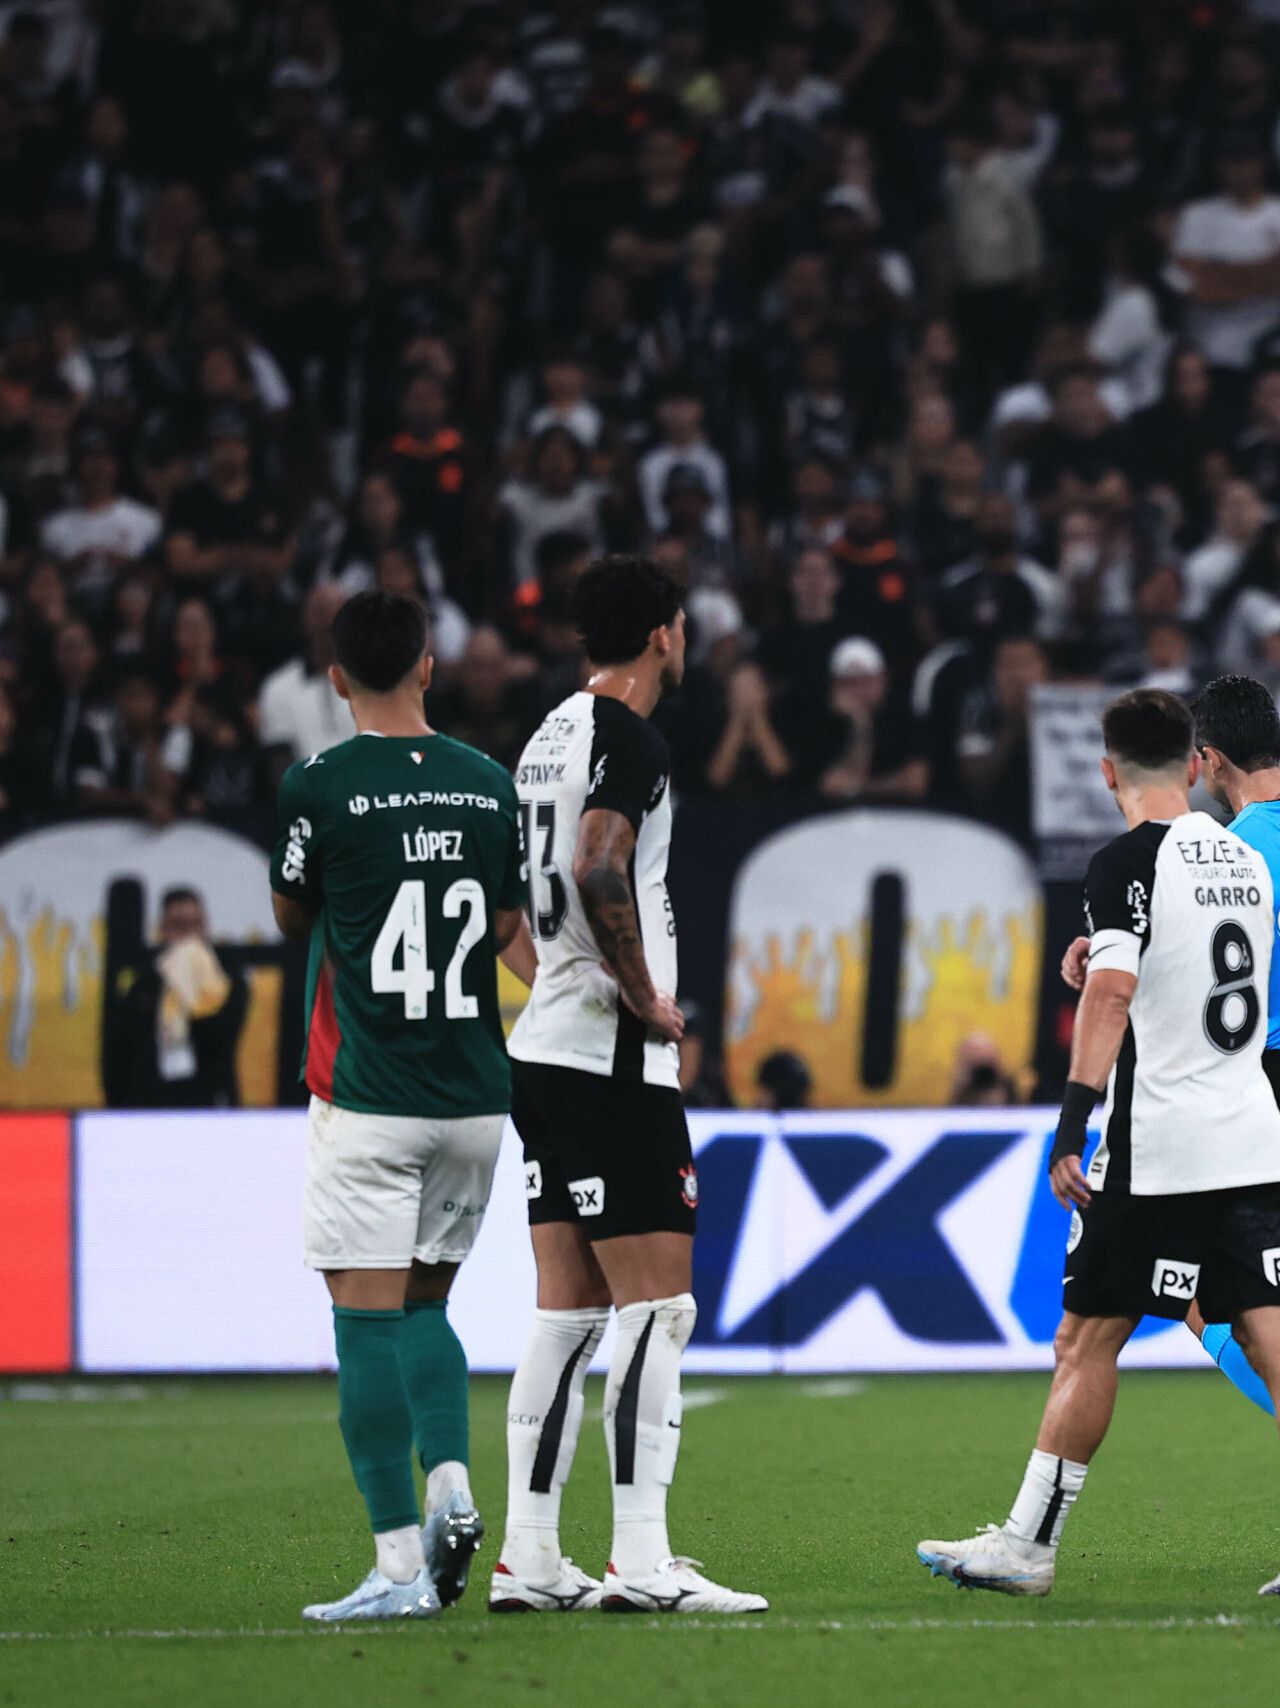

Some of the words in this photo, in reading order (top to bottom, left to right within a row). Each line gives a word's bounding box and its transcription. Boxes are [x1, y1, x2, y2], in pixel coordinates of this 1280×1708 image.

[374, 792, 499, 811] LEAPMOTOR
[403, 825, 464, 862] LÓPEZ
[1176, 839, 1235, 864] EZZE
[1230, 867, 1256, 879] AUTO
[1194, 885, 1261, 907] GARRO
[371, 878, 487, 1020] 42
[1203, 919, 1260, 1056] 8
[1161, 1268, 1196, 1296] px
[510, 1412, 540, 1425] CCP
